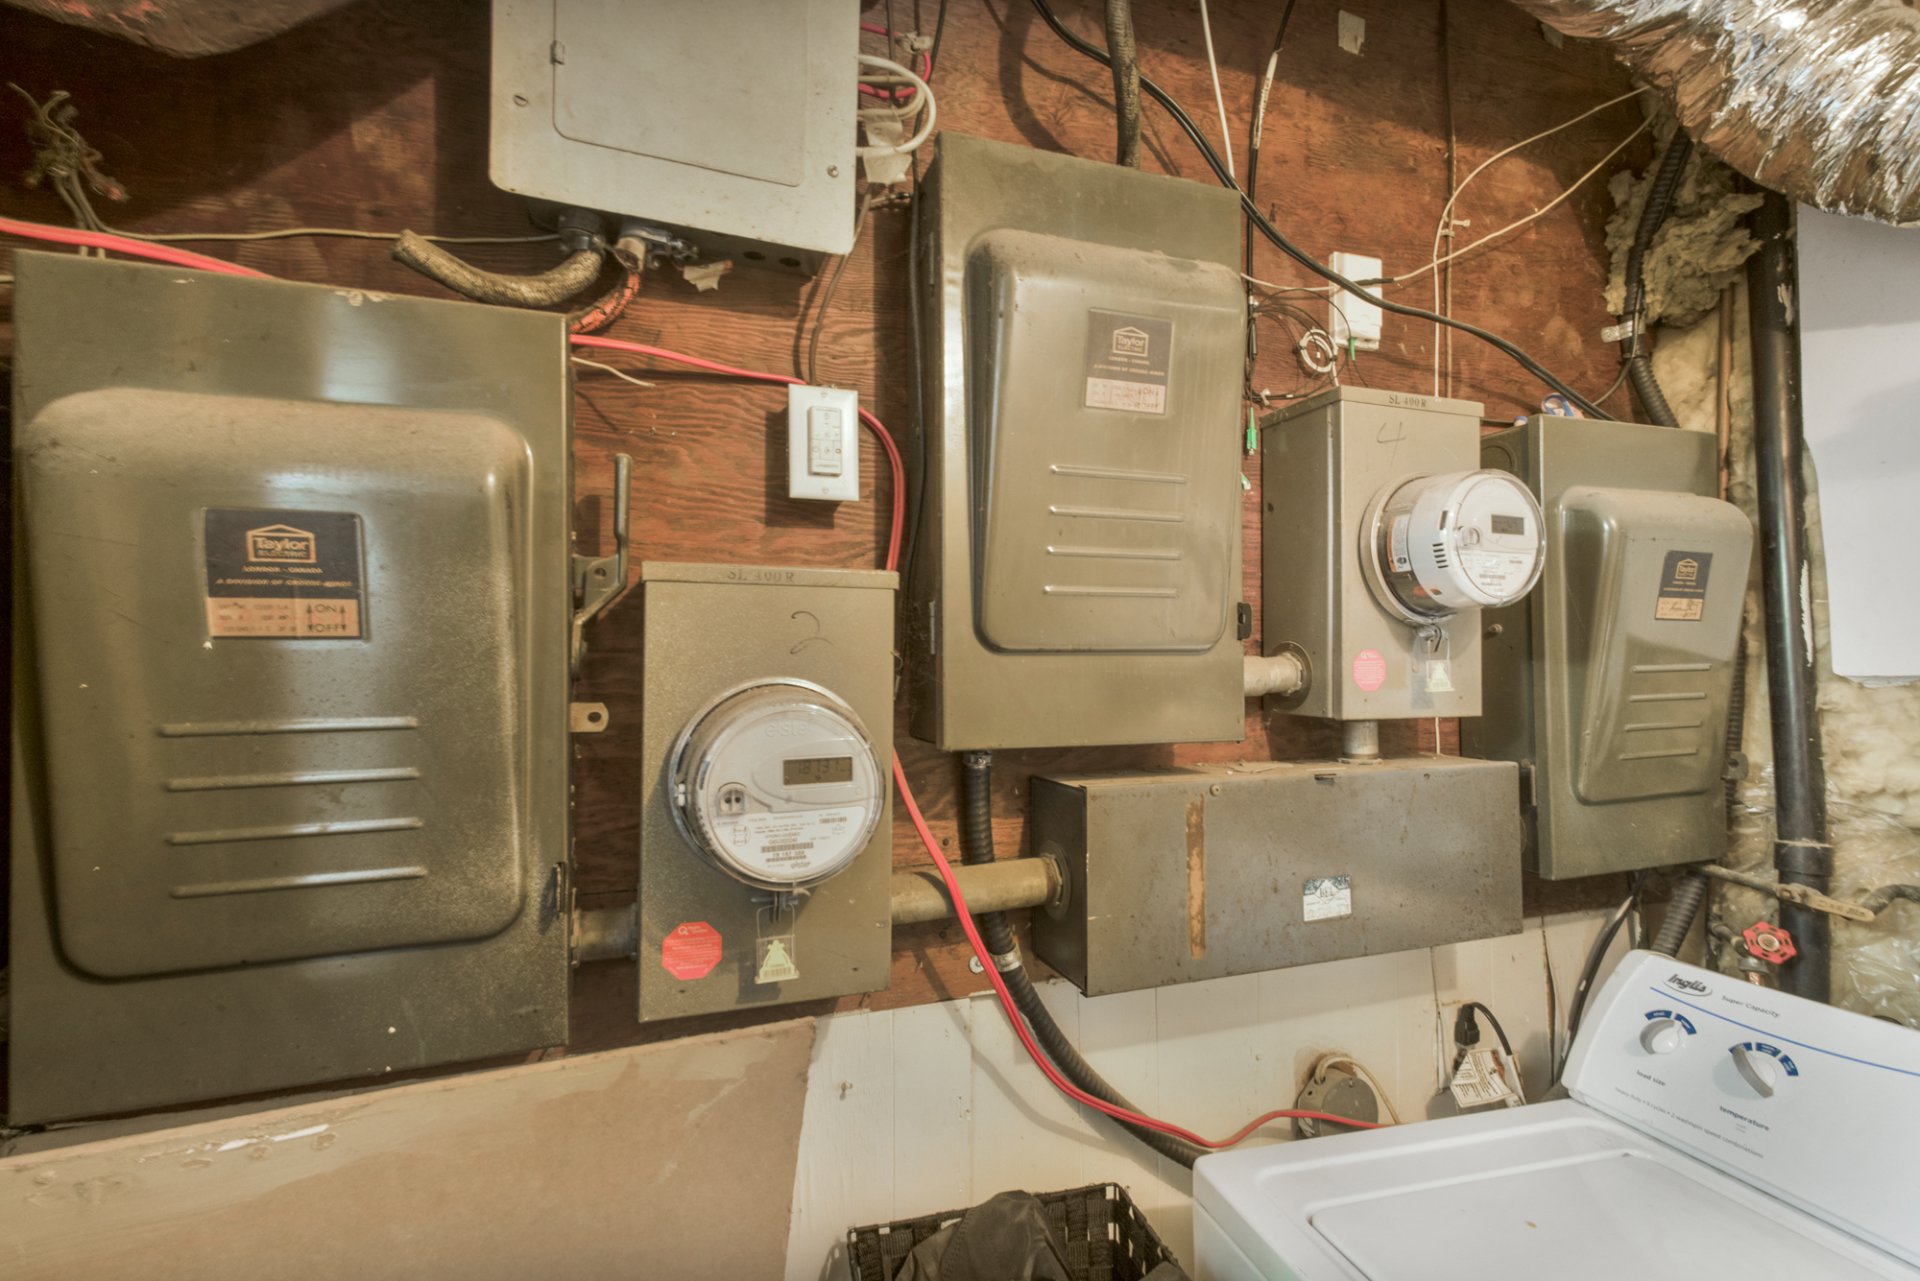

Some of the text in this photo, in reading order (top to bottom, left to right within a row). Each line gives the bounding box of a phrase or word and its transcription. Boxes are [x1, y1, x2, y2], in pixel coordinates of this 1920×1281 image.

[1117, 335, 1145, 347] Taylor
[1376, 420, 1408, 462] 4
[253, 536, 310, 551] Taylor
[315, 603, 337, 613] ON
[315, 623, 342, 633] OFF
[789, 610, 834, 655] 2
[1667, 973, 1780, 1018] Inglis Super Capacity
[1636, 1068, 1666, 1087] load size
[1719, 1104, 1770, 1132] temperature
